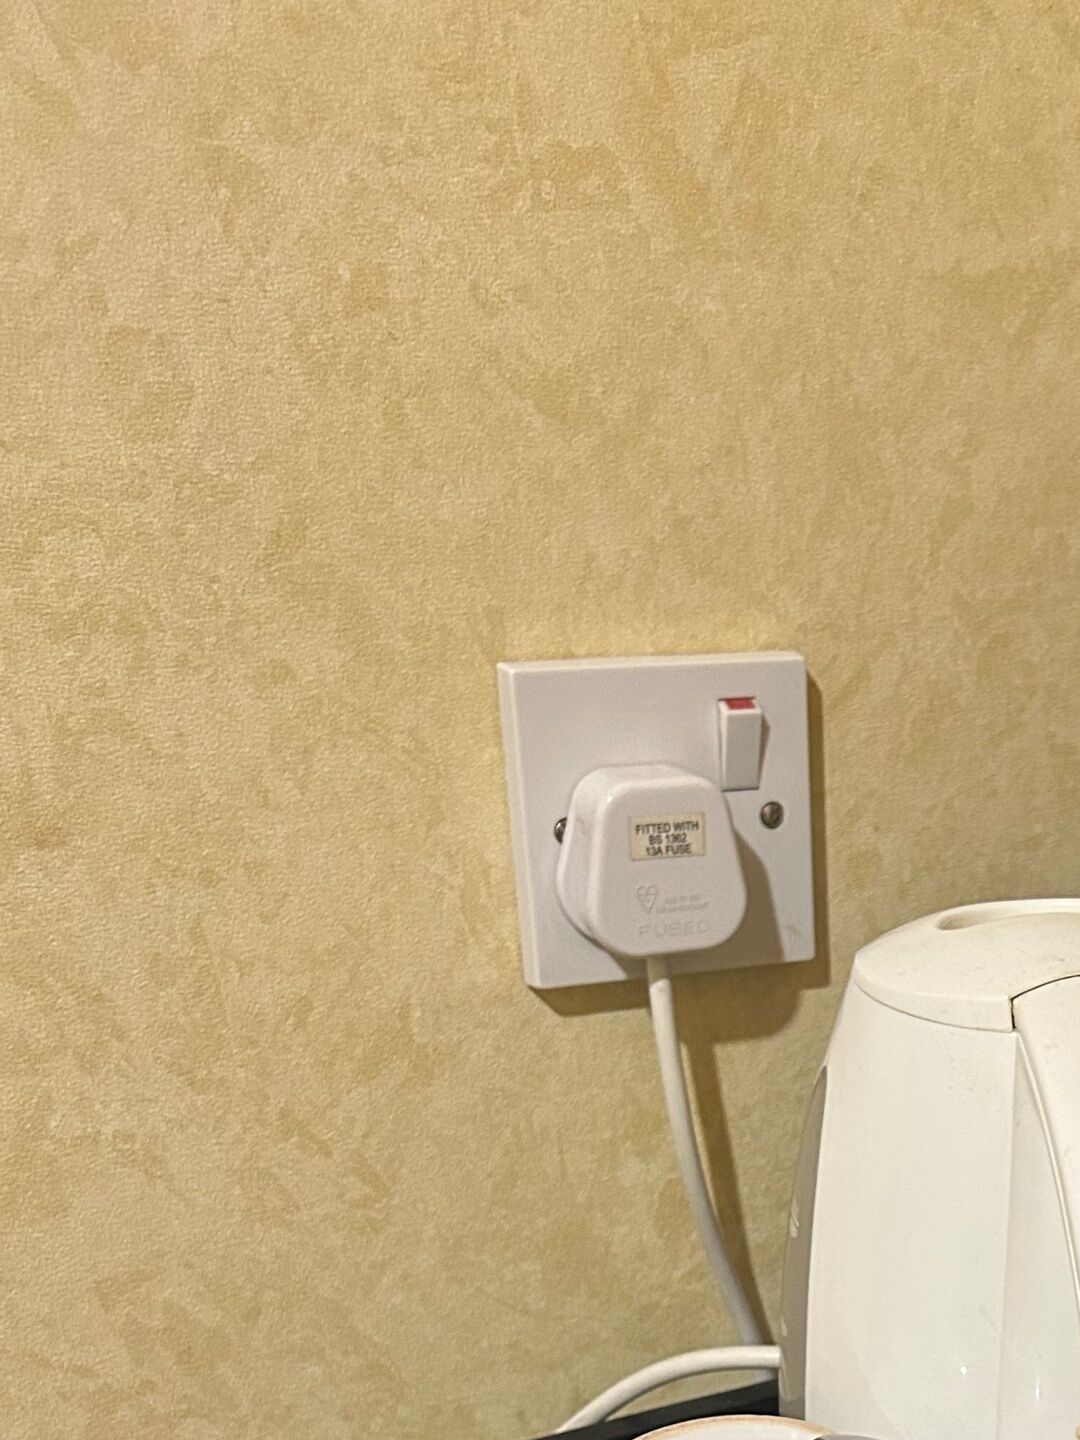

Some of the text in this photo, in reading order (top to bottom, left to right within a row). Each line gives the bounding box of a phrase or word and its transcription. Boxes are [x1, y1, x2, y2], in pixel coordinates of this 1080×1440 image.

[636, 820, 699, 834] FITTED WITH
[646, 843, 692, 856] 13A FUSE
